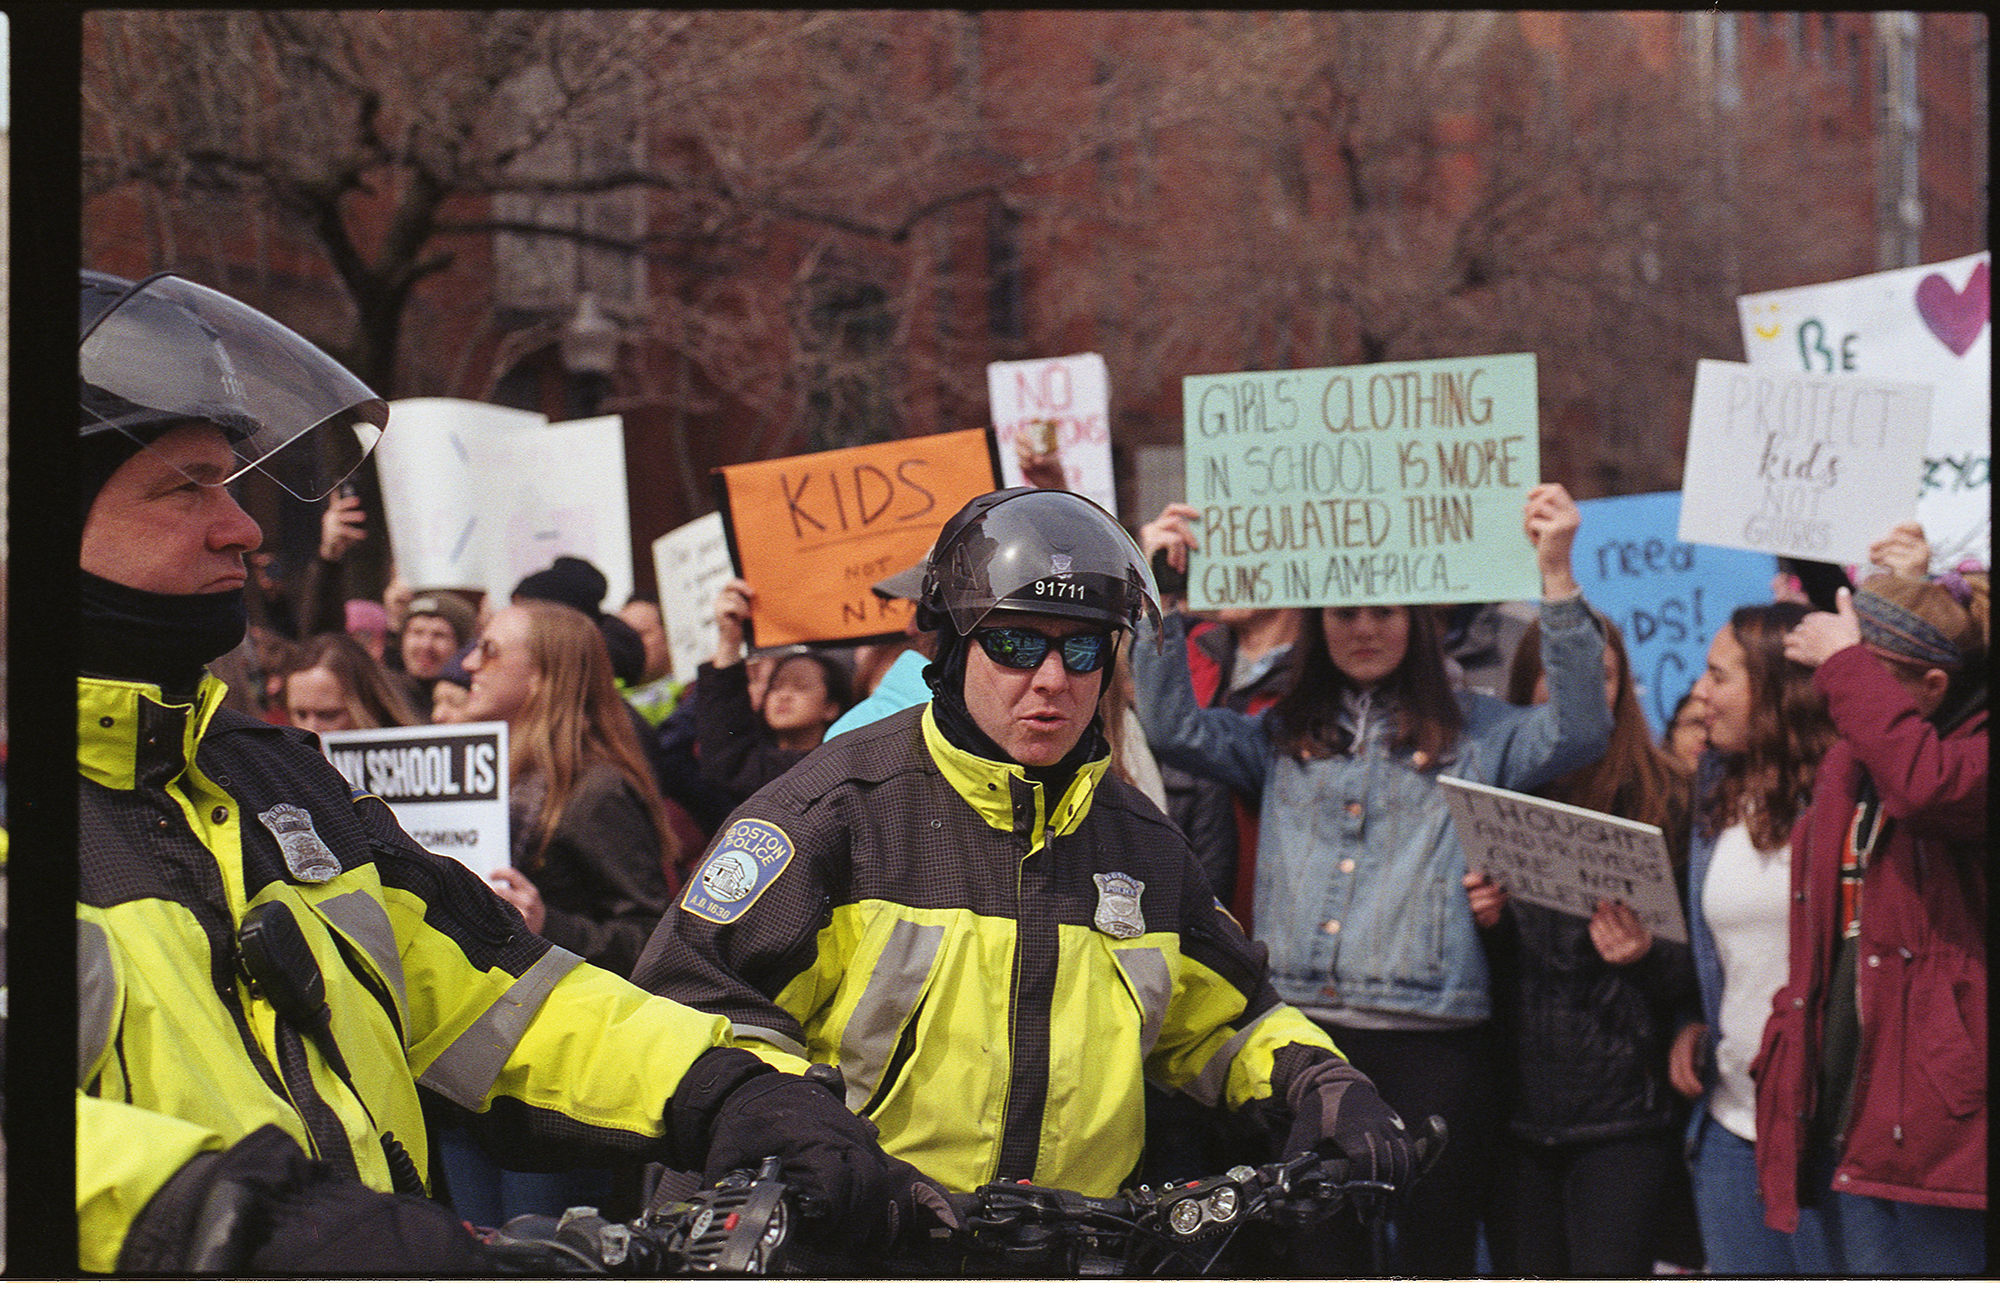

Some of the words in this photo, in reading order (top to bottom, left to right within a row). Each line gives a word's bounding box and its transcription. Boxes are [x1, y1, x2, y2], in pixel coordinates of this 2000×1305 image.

[1797, 317, 1859, 374] BE
[1014, 362, 1073, 413] NO
[1321, 369, 1493, 433] CLOTHING
[1725, 373, 1899, 449] PROTECT
[1203, 453, 1231, 499] IN
[1243, 438, 1385, 495] SCHOOL
[1396, 440, 1430, 488] IS
[1436, 435, 1526, 490] MORE
[1758, 431, 1838, 488] kids
[780, 460, 936, 540] KIDS
[1204, 498, 1391, 558] REGULATED
[1404, 494, 1474, 547] THAN
[1761, 484, 1824, 517] NOT
[844, 555, 890, 582] NOT
[1035, 580, 1085, 600] 91711
[1203, 559, 1273, 605] GUNS
[1283, 560, 1310, 600] IN
[366, 745, 460, 797] SCHOOL
[464, 743, 496, 795] IS
[724, 837, 775, 867] POLICE
[726, 825, 787, 860] BOSTON
[690, 894, 706, 909] A.D.
[705, 900, 731, 920] 1630
